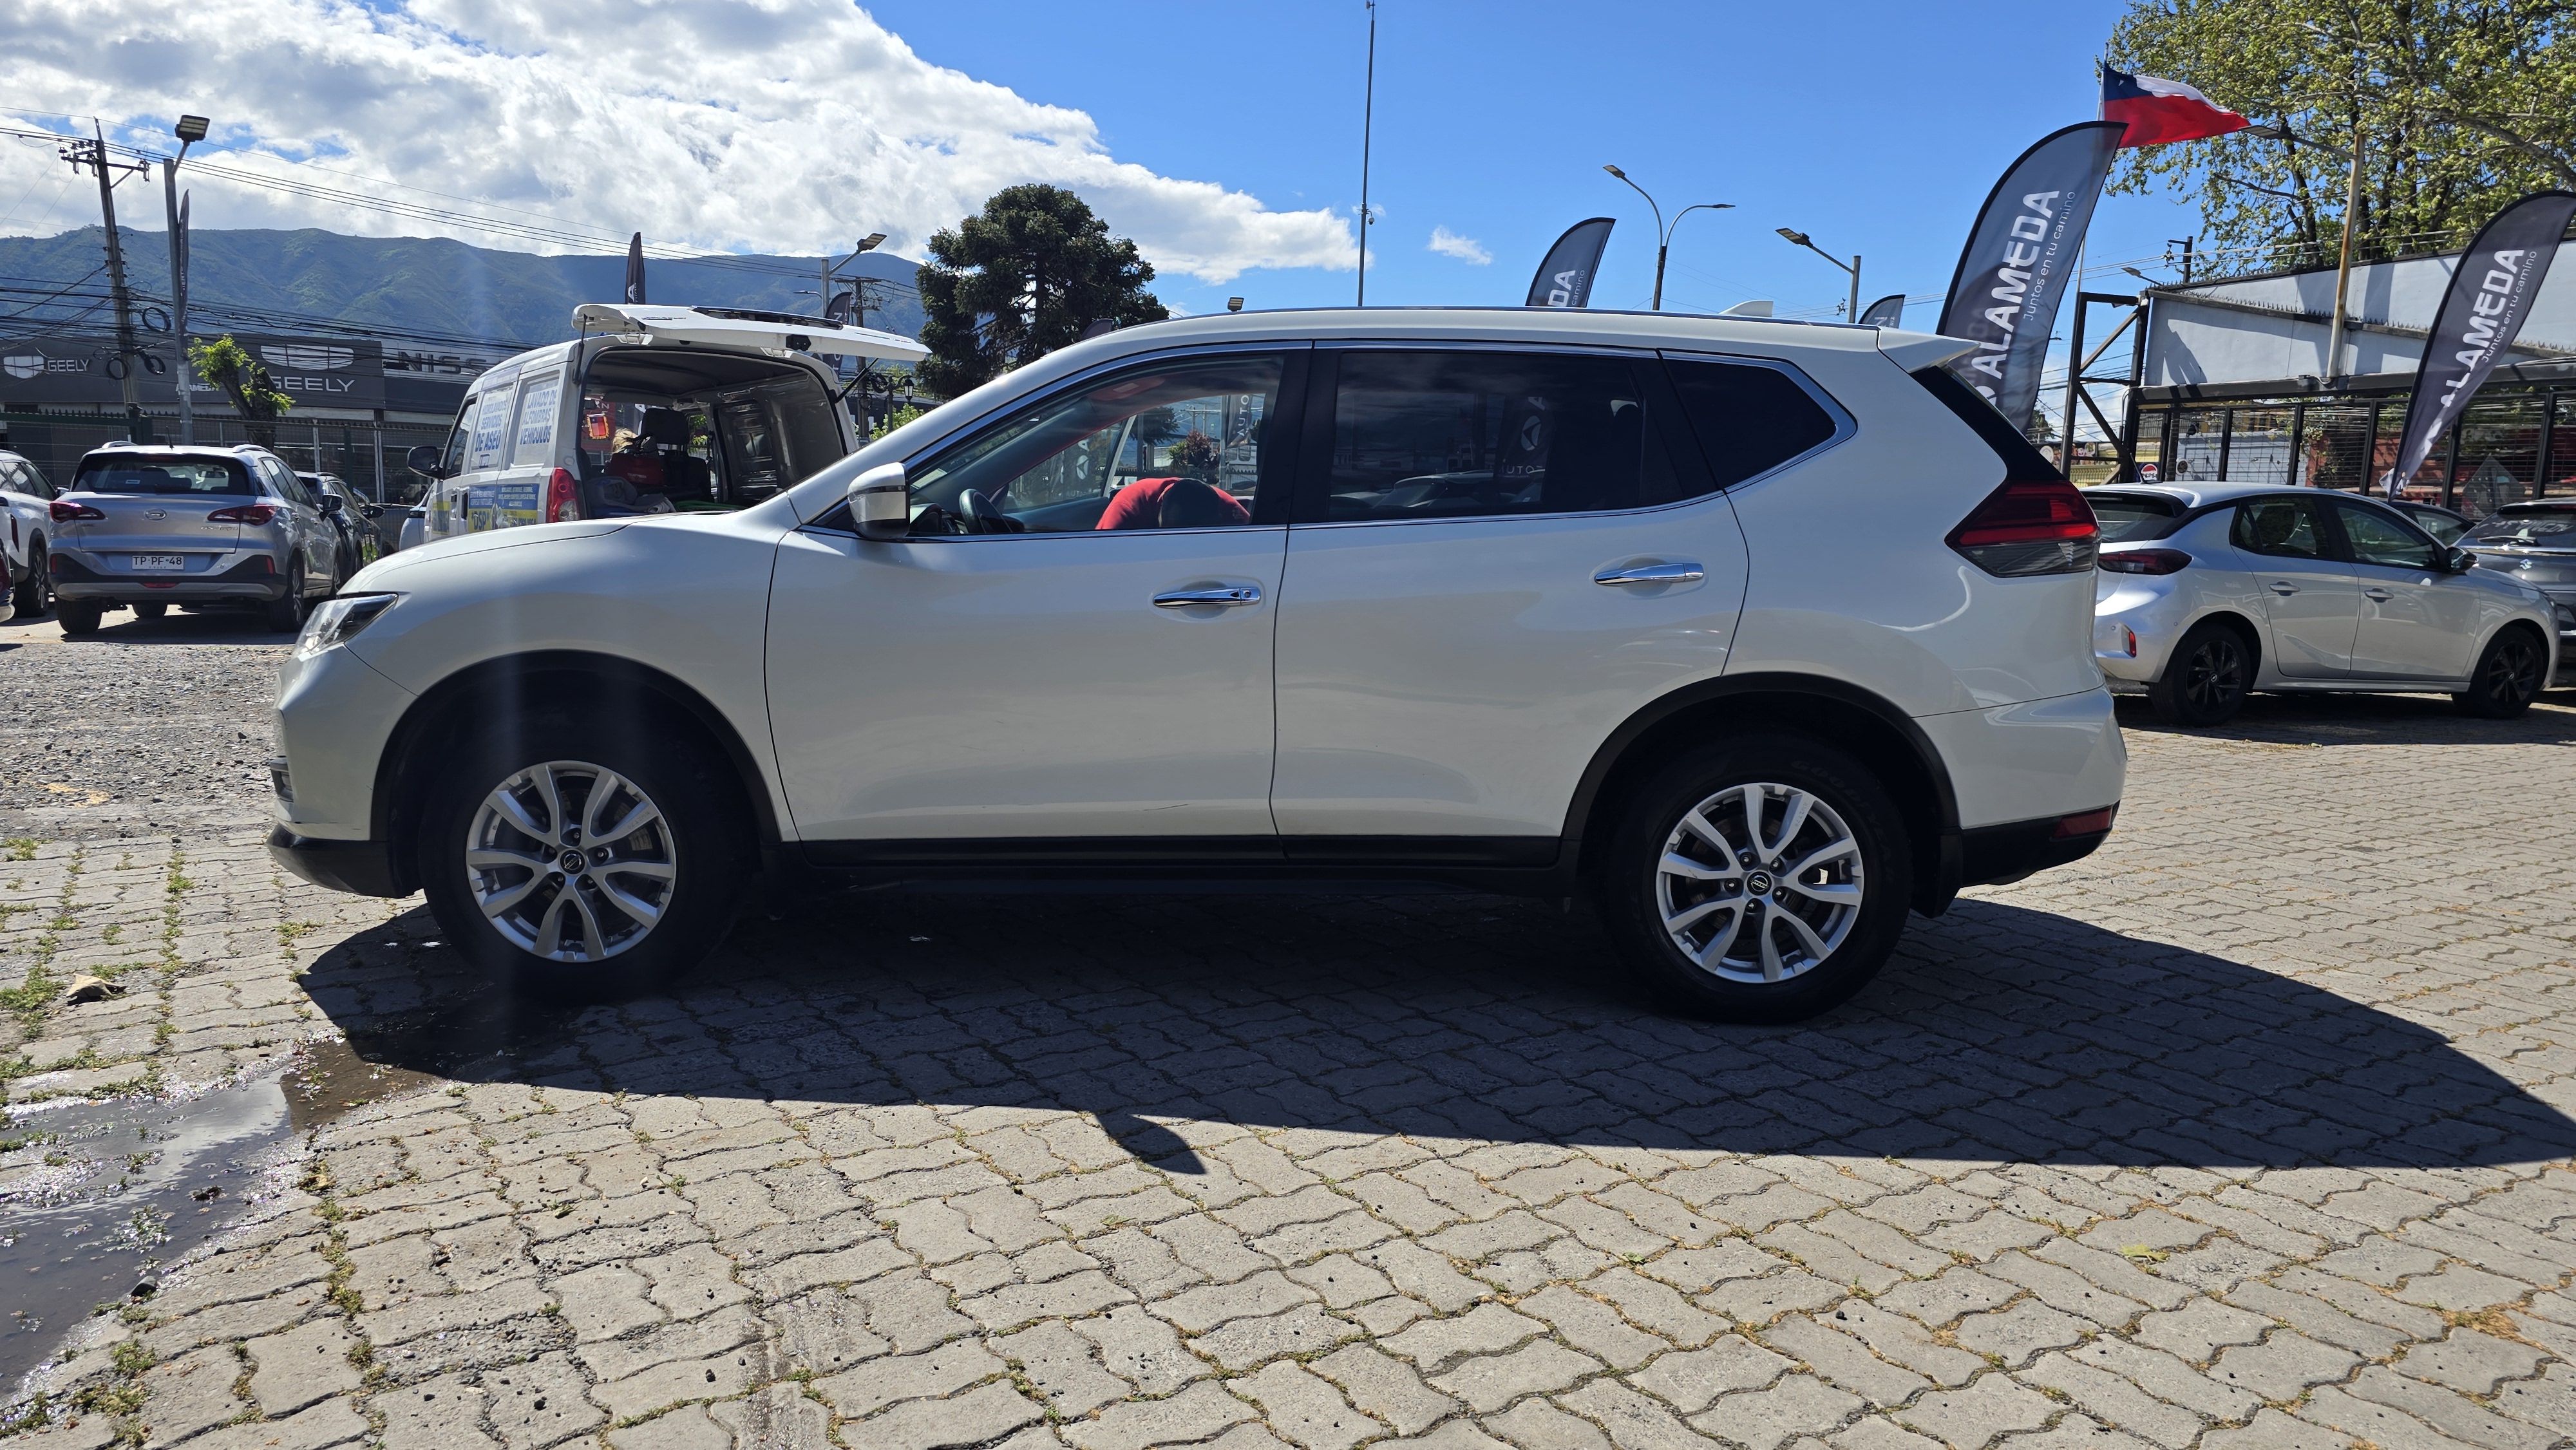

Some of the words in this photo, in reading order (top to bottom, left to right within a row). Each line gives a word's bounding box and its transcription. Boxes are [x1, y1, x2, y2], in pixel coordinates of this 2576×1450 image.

[2023, 278, 2045, 321] Juntos
[2040, 259, 2052, 276] en
[2046, 242, 2058, 256] tu
[2053, 191, 2075, 239] camino
[1571, 270, 1585, 305] camino
[1971, 191, 2060, 380] ALAMEDA
[2481, 326, 2506, 362] Juntos
[2504, 310, 2514, 325] en
[2510, 295, 2519, 307] tu
[2515, 251, 2537, 293] camino
[48, 359, 89, 372] GEELY
[527, 390, 550, 409] LAVADO
[549, 389, 558, 406] DE
[522, 408, 552, 426] ALFOMBRAS
[475, 432, 485, 452] DE
[484, 429, 502, 451] ASEO
[520, 425, 552, 445] VEHICULOS
